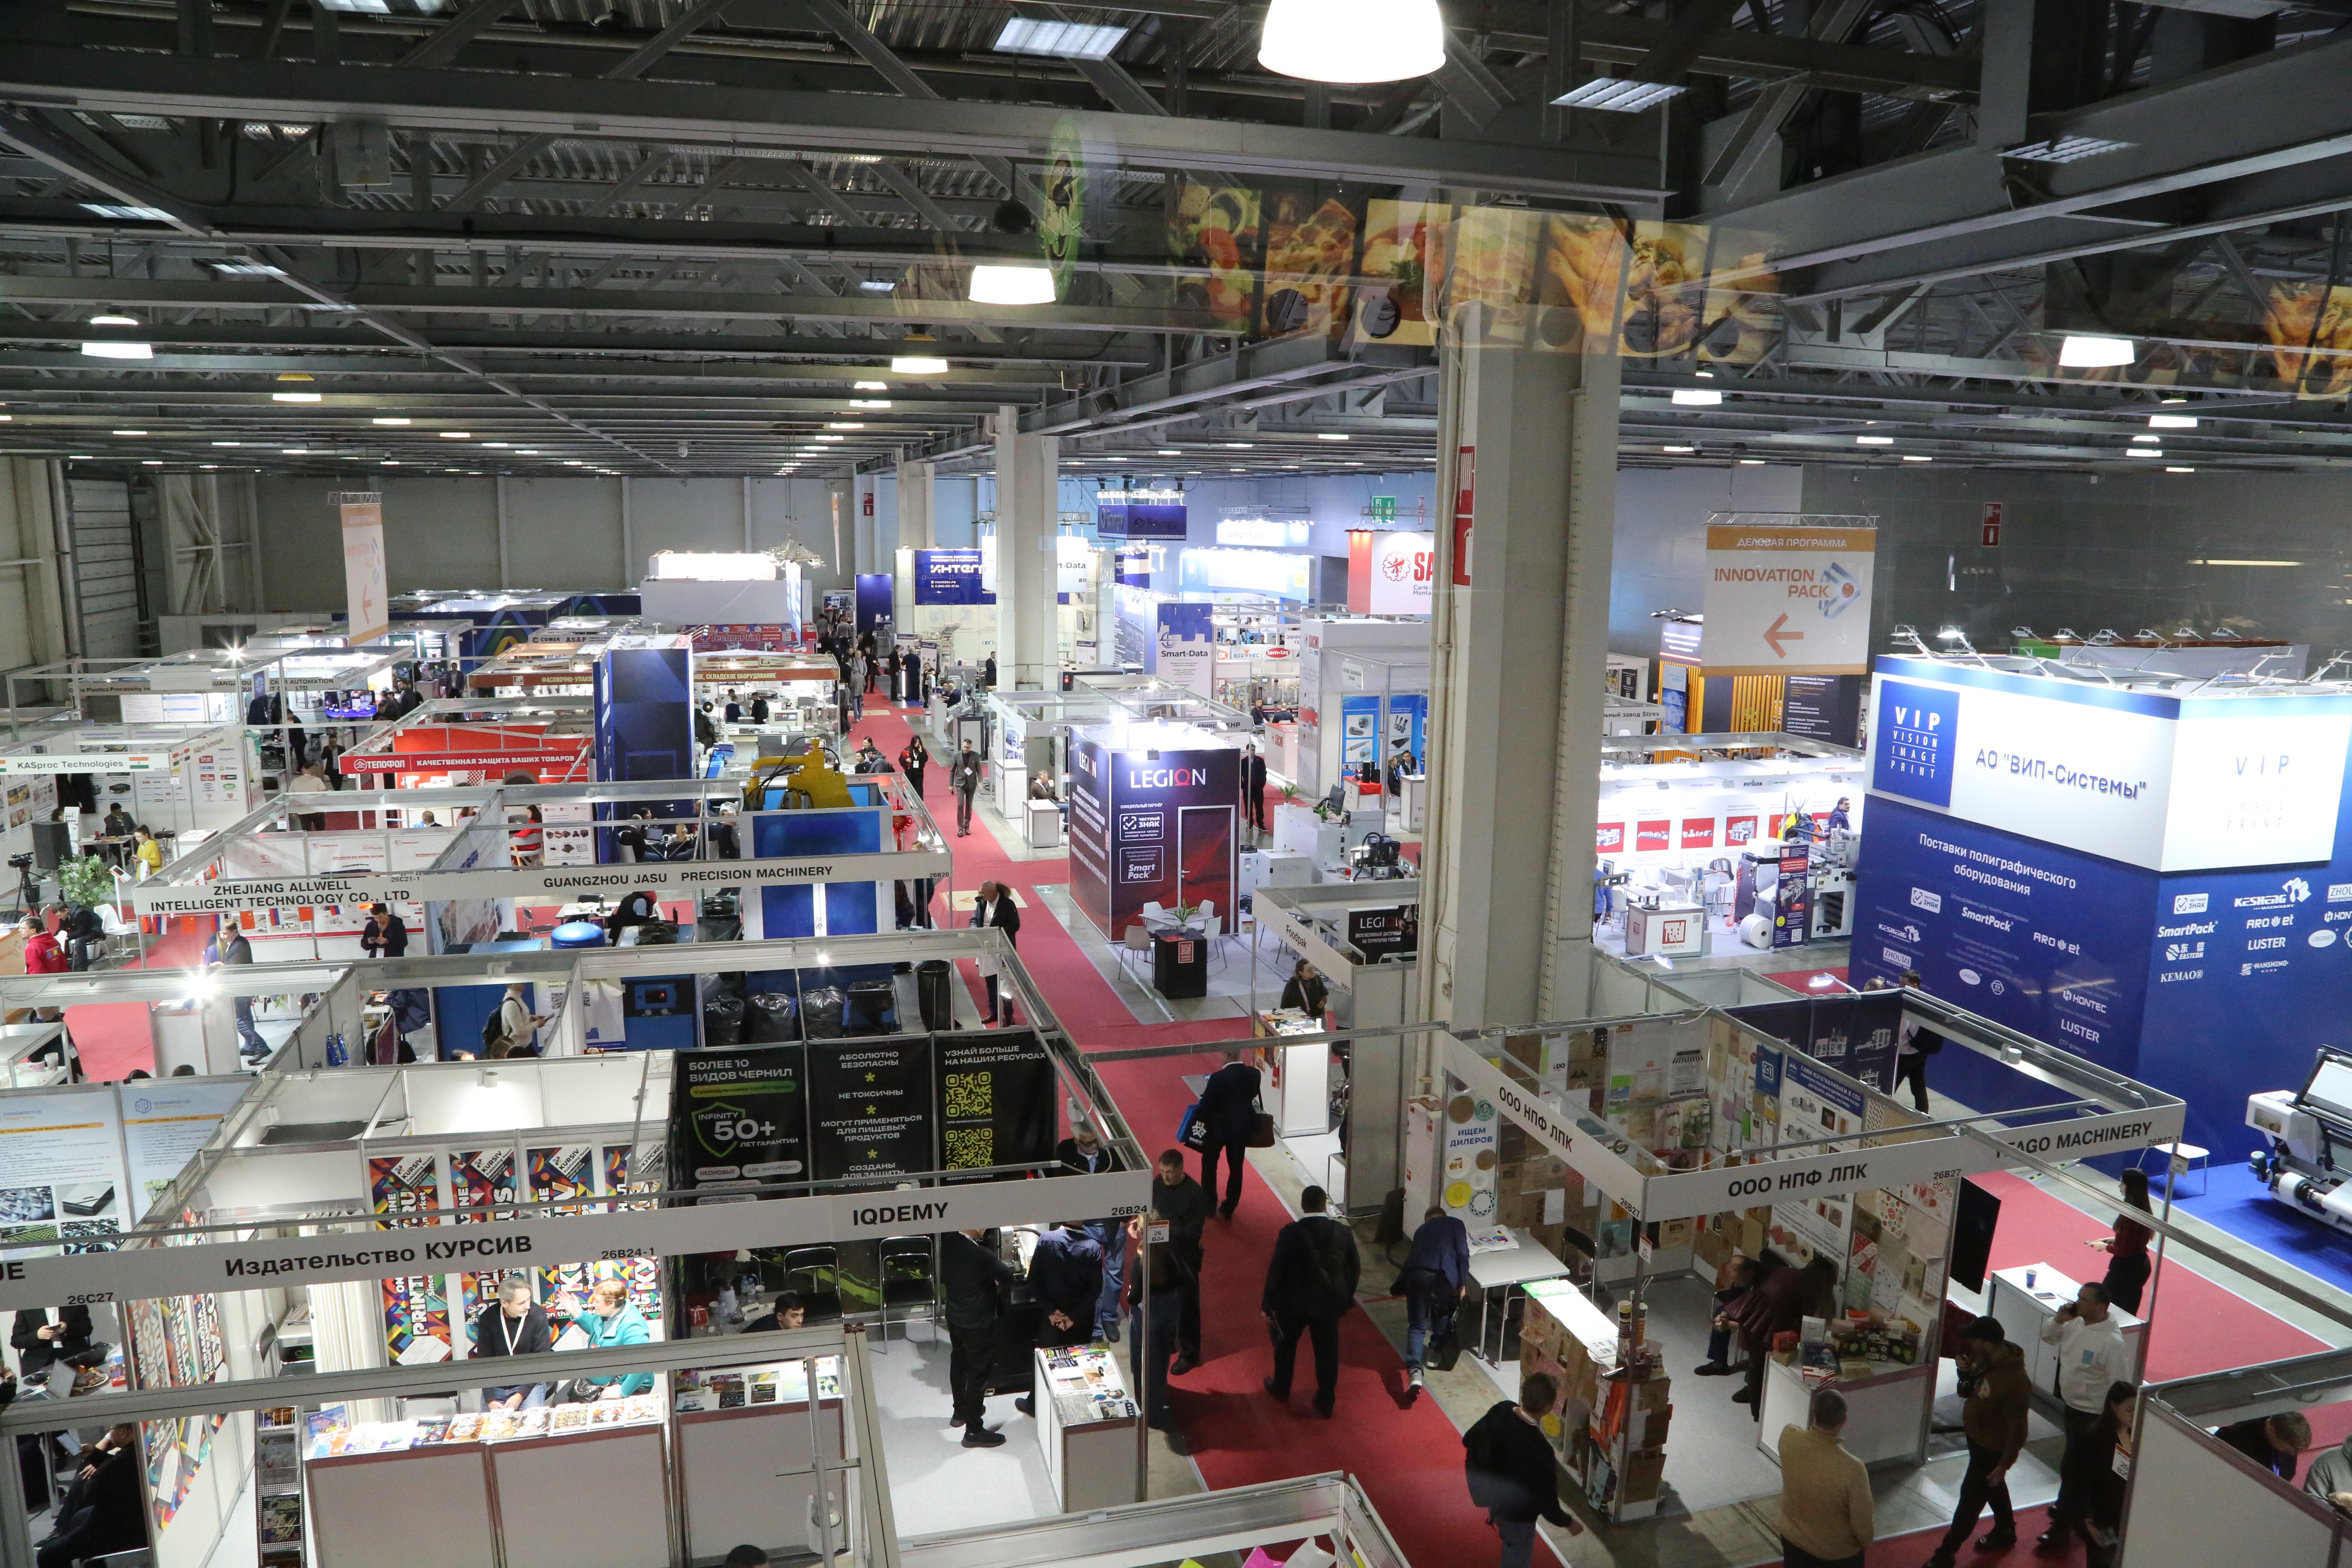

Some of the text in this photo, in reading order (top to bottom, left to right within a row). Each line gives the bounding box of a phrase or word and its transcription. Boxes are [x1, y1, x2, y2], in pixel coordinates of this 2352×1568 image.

[1737, 538, 1783, 547] ДЕЛОВАЯ
[1715, 568, 1814, 581] INNOVATION
[1788, 585, 1829, 598] PACK
[711, 633, 760, 641] TechnoPrint
[1895, 706, 1940, 731] VIP
[1893, 731, 1938, 748] VISION
[1892, 745, 1936, 764] IMAGE
[18, 760, 123, 771] KASproc Technologies
[367, 760, 405, 769] ТЕПОФОЛ
[416, 758, 476, 766] КАЧЕСТВЕННАЯ
[1891, 760, 1935, 778] PRINT
[2236, 755, 2289, 775] VIP
[1976, 748, 2146, 800] АО "ВИП-Системы"
[2227, 817, 2281, 831] PRINT
[1920, 833, 2076, 889] Поставки полиграфического
[544, 866, 833, 887] GUANGZHOU JASU PRECISION MACHINERY
[1954, 864, 2030, 895] оборудования
[214, 880, 352, 895] ZHEJIANG ALLWELL
[151, 890, 410, 912] INTELLIGENT TECHNOLOGY CO., LTD
[1924, 900, 1939, 909] ЗНАК
[2234, 894, 2287, 908] KESHENG
[1287, 925, 1307, 949] Foodpak
[1879, 923, 1907, 939] KESHENG
[2247, 937, 2286, 951] LUSTER
[2179, 951, 2203, 960] EASTCOM
[2160, 970, 2203, 982] KEMAO®
[2073, 994, 2107, 1013] HONTEC
[2061, 1018, 2100, 1043] LUSTER
[839, 1051, 899, 1061] АБСОЛЮТНО
[945, 1046, 1019, 1057] УЗНАЙ БОЛЬШЕ
[960, 1056, 996, 1064] НАШИХ
[997, 1052, 1046, 1061] РЕСУРСАХ
[689, 1059, 749, 1071] БОЛЕЕ 10
[841, 1059, 898, 1069] БЕЗОПАСНЫ
[690, 1069, 792, 1082] ВИДОВ ЧЕРНИЛ
[700, 1086, 748, 1095] уникальными
[852, 1089, 903, 1098] ТОКСИЧНЫ
[698, 1112, 739, 1120] INFINITY
[854, 1115, 922, 1126] ПРИМЕНЯТЬСЯ
[1499, 1087, 1573, 1152] ООО НПФ ЛПК
[714, 1119, 775, 1140] 50+
[858, 1124, 906, 1134] ПИЩЕВЫХ
[1458, 1127, 1486, 1136] ИЩЕМ
[2057, 1122, 2152, 1149] MACHINERY
[755, 1138, 798, 1147] ГАРАНТИИ
[845, 1132, 900, 1142] ПРОДУКТОВ
[1450, 1135, 1492, 1148] ДИЛЕРОВ
[2147, 1136, 2180, 1147] 26B27-1
[481, 1151, 503, 1173] KURSIV
[559, 1149, 579, 1170] KURSIV
[401, 1157, 423, 1180] KURSIV
[849, 1162, 895, 1172] СОЗДАНЫ
[1728, 1164, 1868, 1197] ООО НПФ ЛПК
[1933, 1169, 1961, 1180] 26B27
[853, 1202, 949, 1225] IQDEMY
[1111, 1205, 1147, 1216] 26B24
[1621, 1198, 1640, 1217] 26B27
[225, 1235, 533, 1277] Издательство КУРСИВ
[601, 1247, 655, 1260] 26B24-1
[68, 1293, 114, 1305] 26C27
